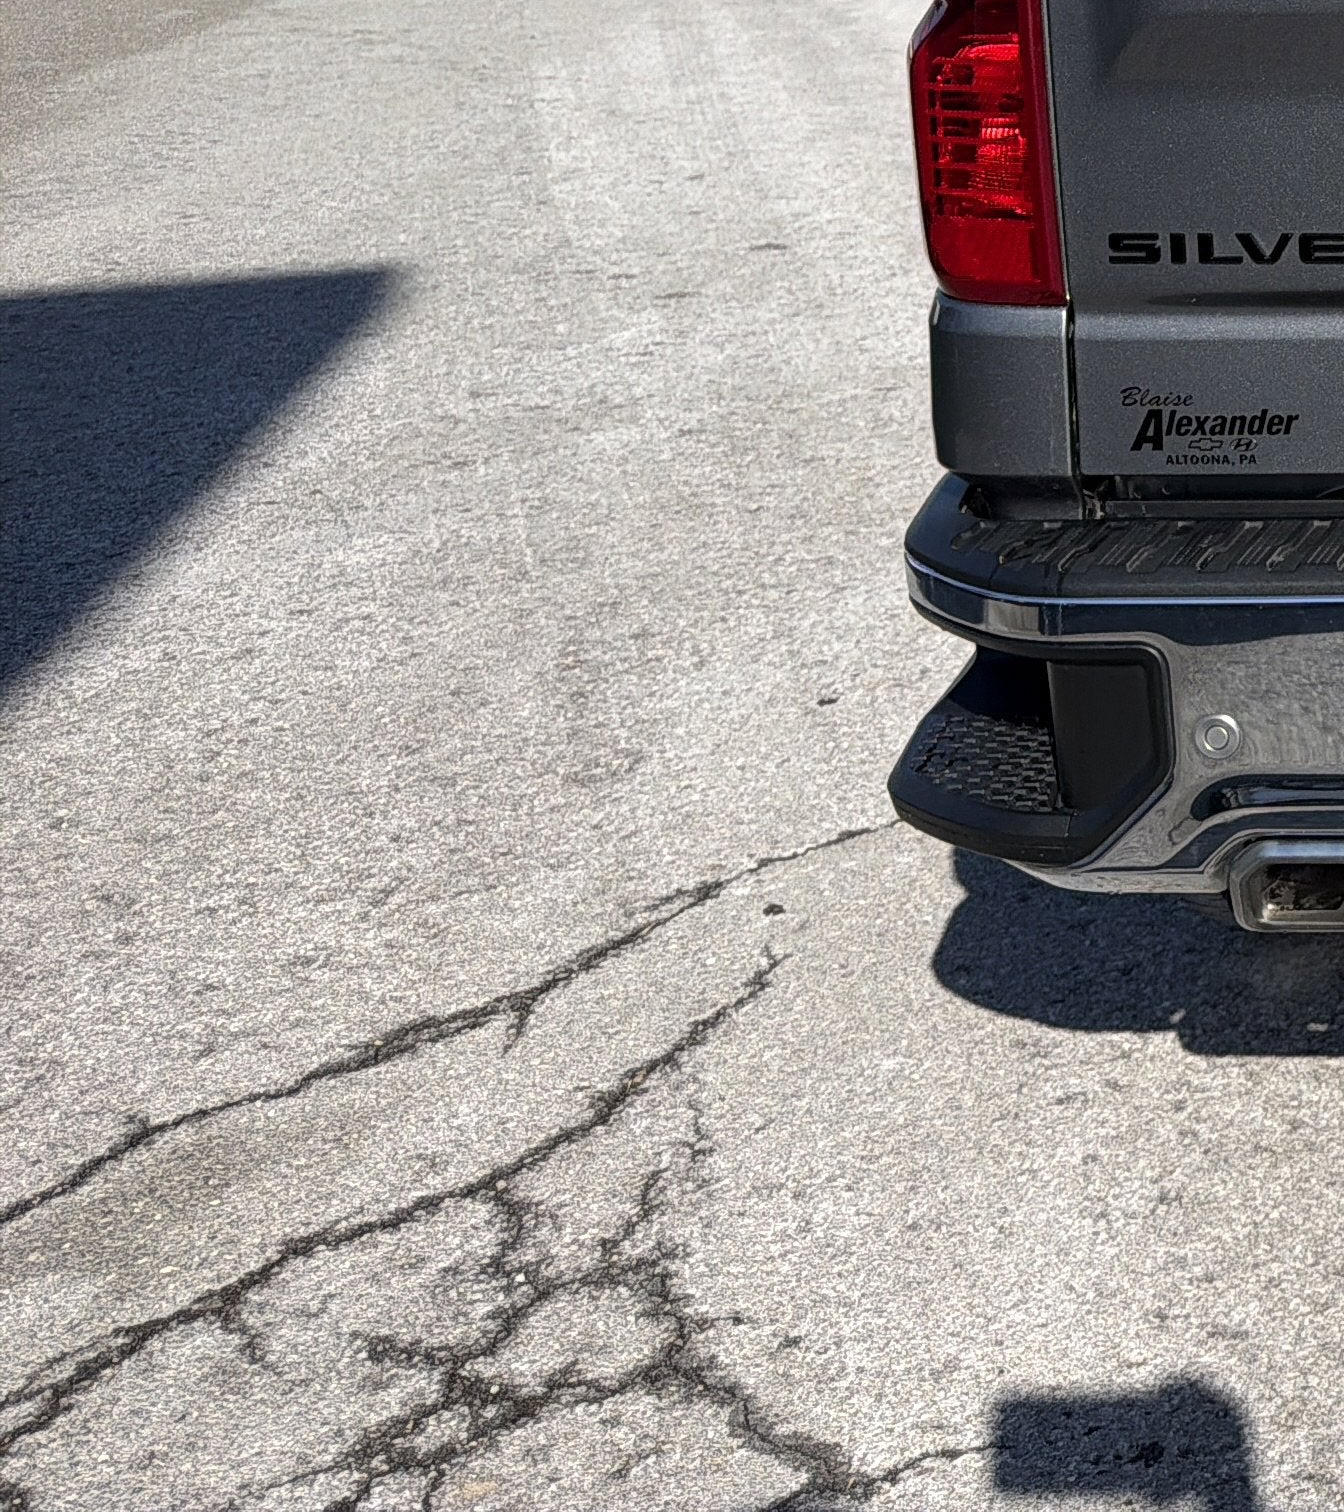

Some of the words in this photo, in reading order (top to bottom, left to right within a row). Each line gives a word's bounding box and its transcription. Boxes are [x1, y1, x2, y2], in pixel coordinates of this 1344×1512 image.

[1119, 386, 1195, 407] Blaise
[1130, 408, 1300, 452] Alexander
[1166, 454, 1235, 467] ALTOONA,
[1239, 454, 1257, 466] PA
